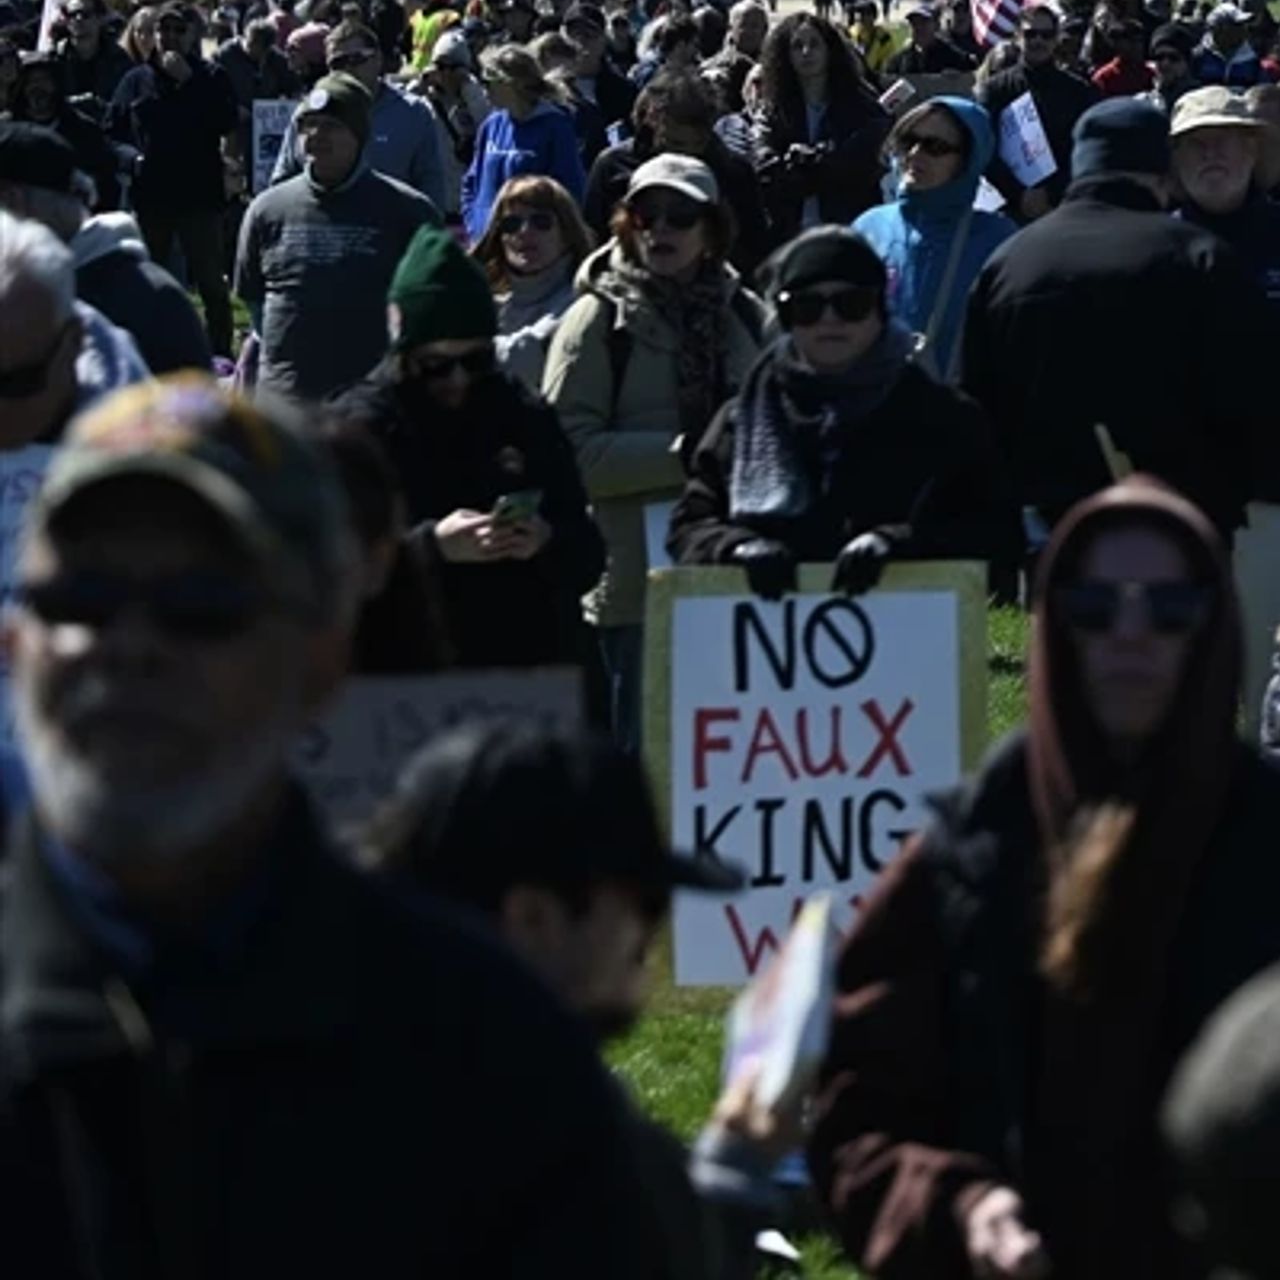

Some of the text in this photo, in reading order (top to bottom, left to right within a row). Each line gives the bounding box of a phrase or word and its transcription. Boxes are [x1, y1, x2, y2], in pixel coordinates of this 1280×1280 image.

[733, 598, 875, 693] NO
[692, 698, 914, 790] FAUX
[694, 789, 917, 888] KING
